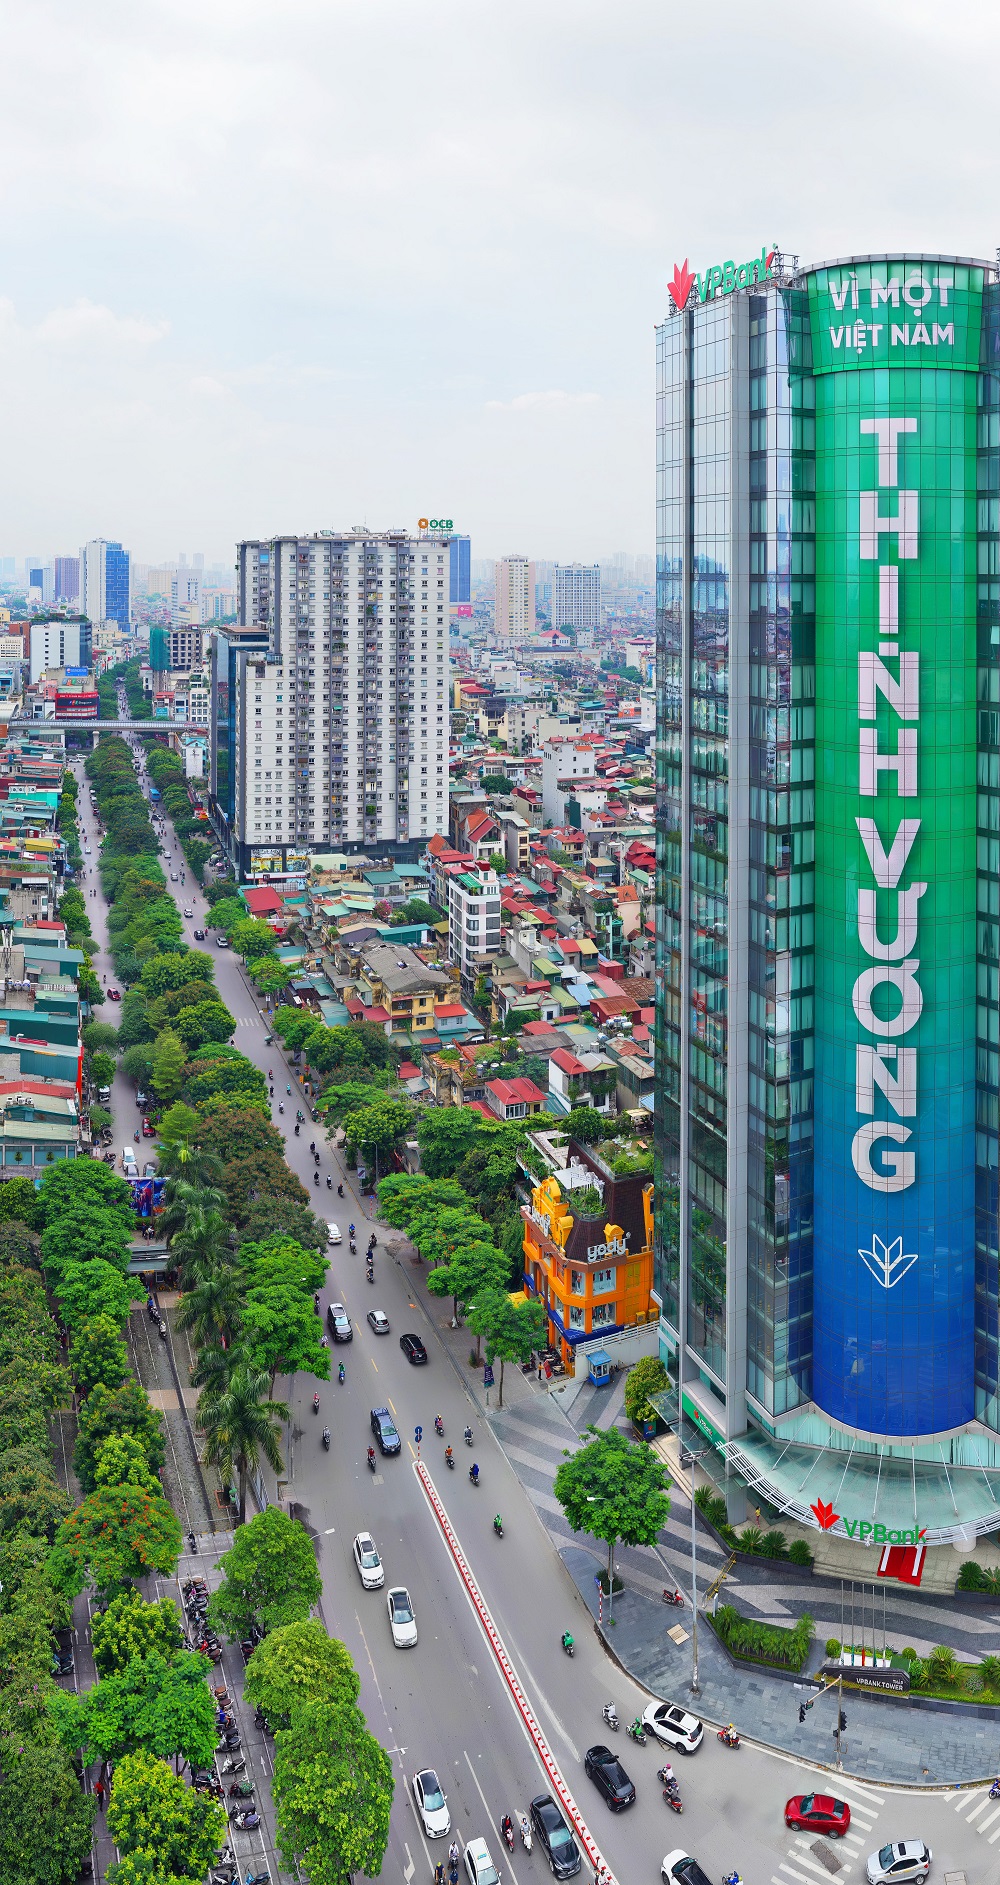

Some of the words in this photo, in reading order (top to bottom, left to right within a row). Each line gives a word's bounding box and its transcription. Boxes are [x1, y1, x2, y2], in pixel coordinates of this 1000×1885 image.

[697, 247, 774, 303] VPBank
[829, 271, 859, 311] VÌ
[870, 269, 954, 317] MỘT
[829, 318, 883, 354] VIỆT
[891, 322, 954, 346] NAM
[429, 519, 454, 529] OCB
[587, 1237, 627, 1262] yody
[843, 1517, 927, 1544] VPBank
[856, 1678, 881, 1687] VPBANK
[882, 1682, 903, 1691] TOWER
